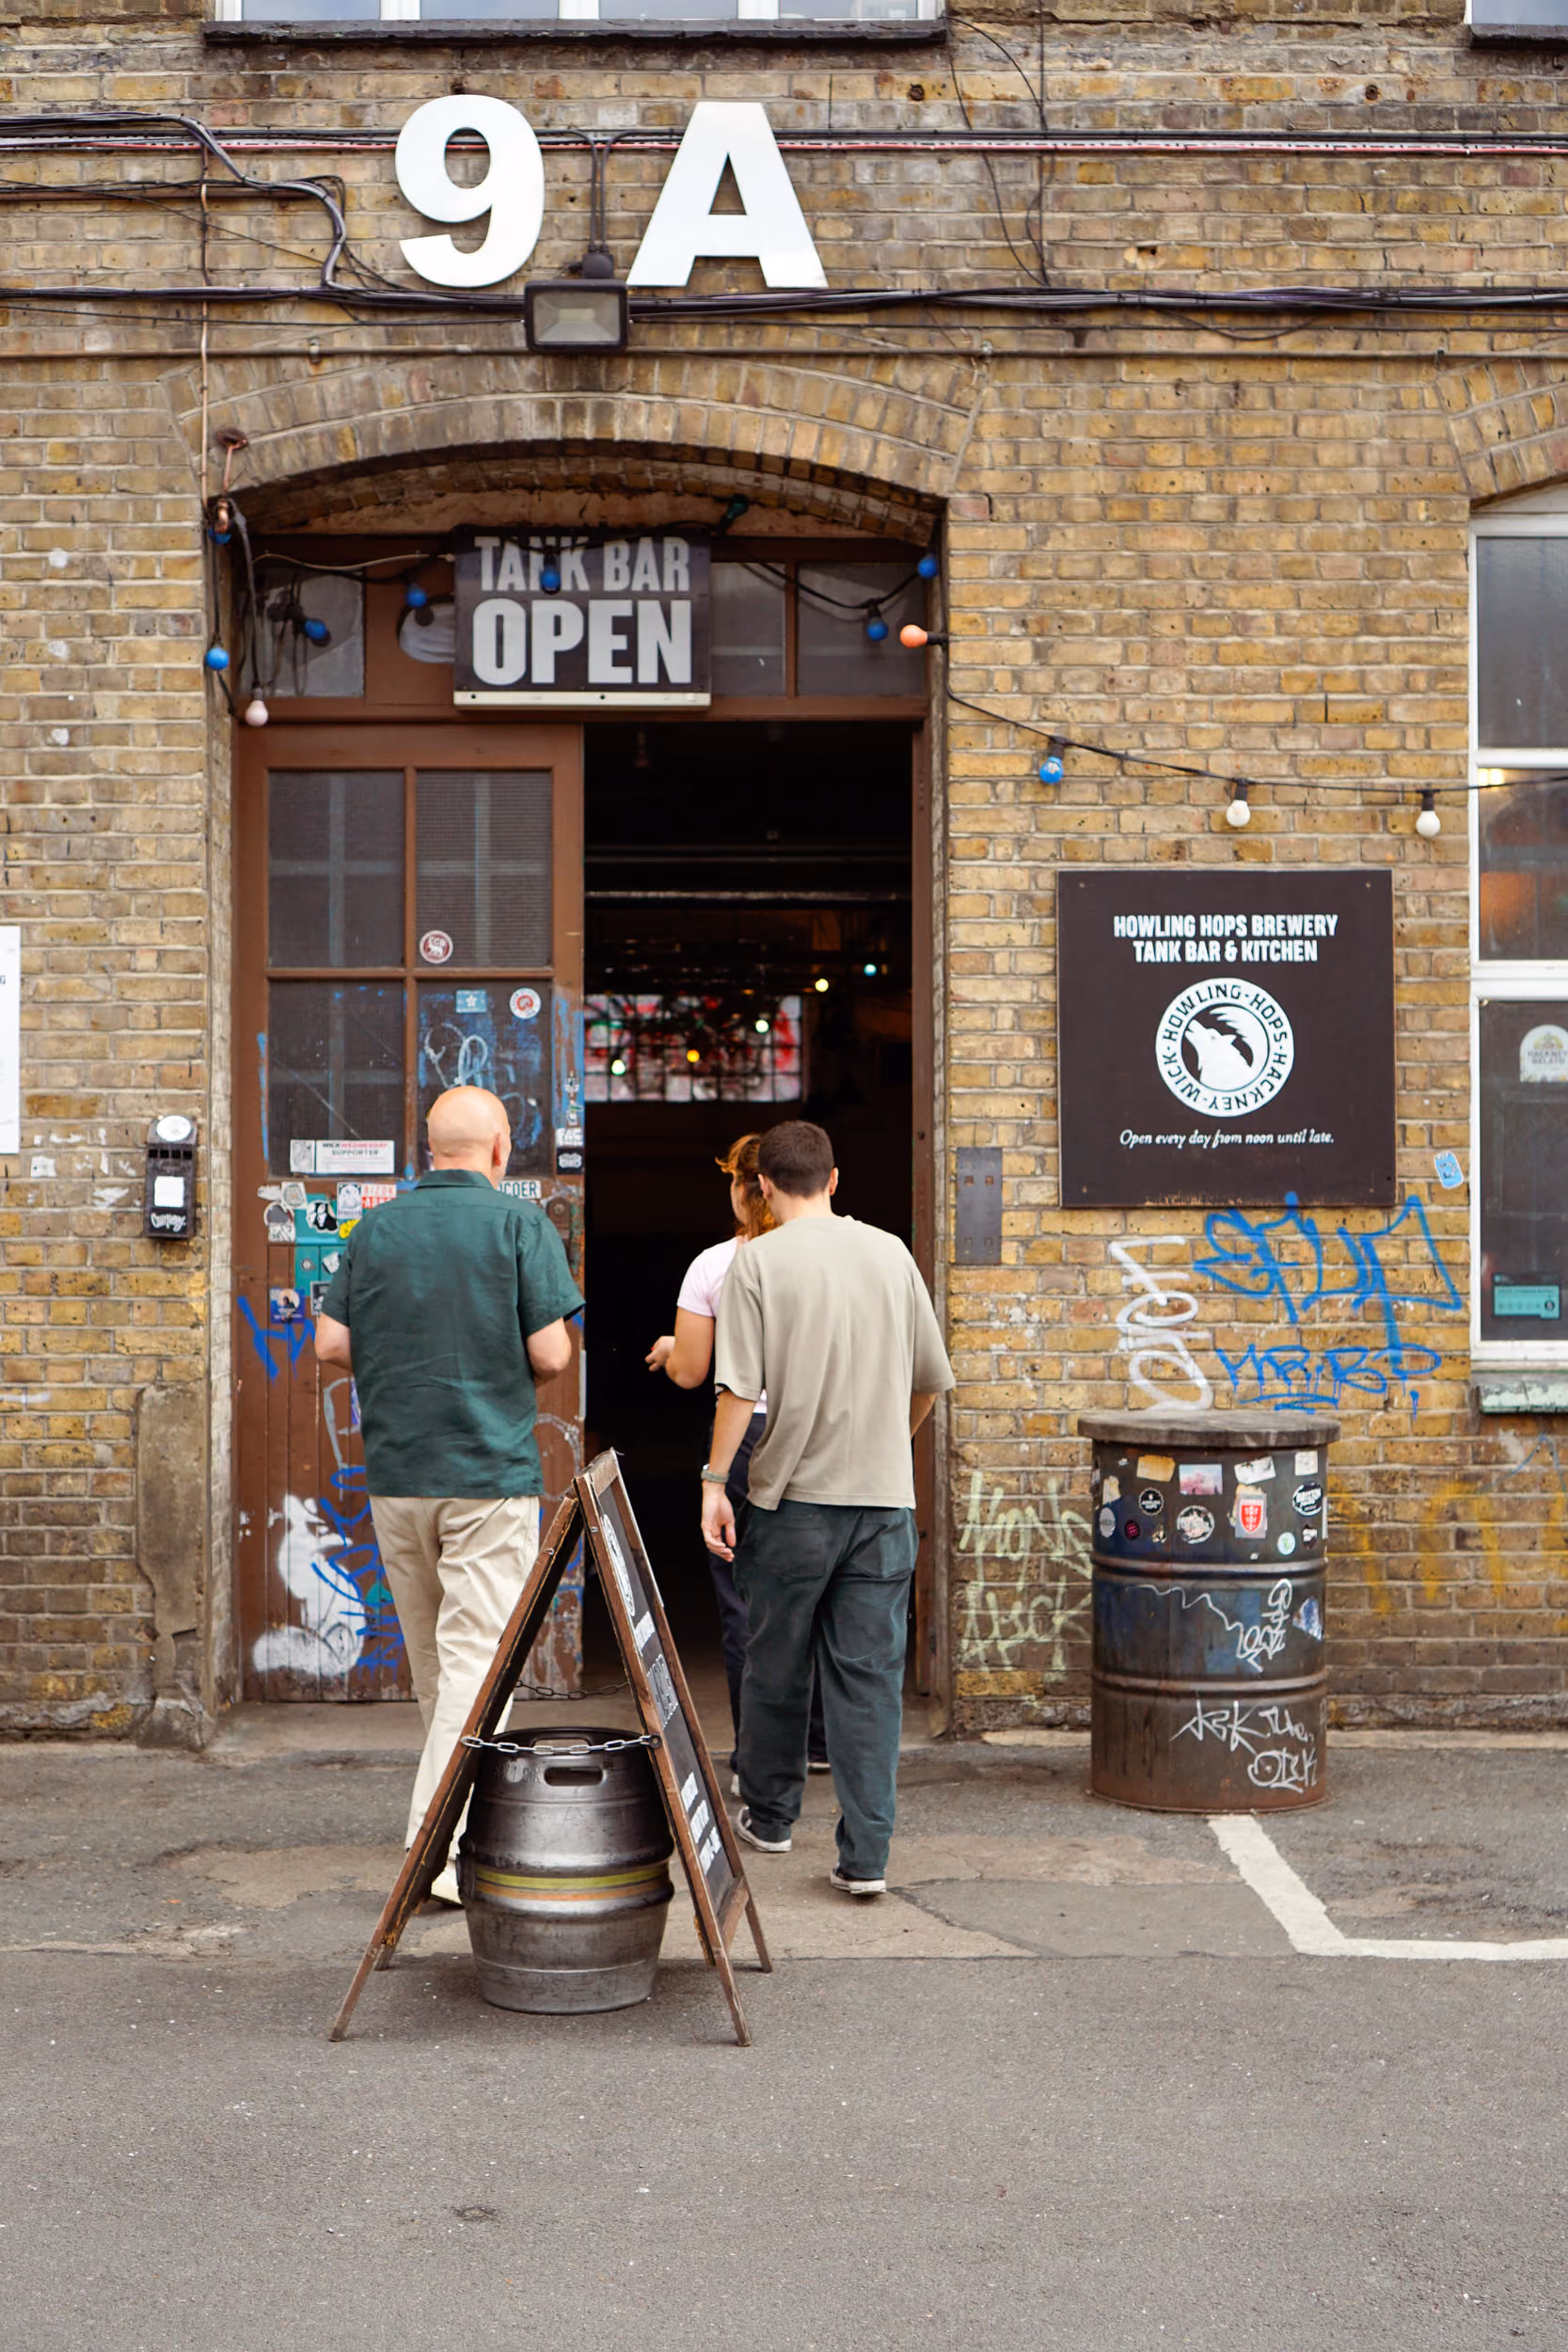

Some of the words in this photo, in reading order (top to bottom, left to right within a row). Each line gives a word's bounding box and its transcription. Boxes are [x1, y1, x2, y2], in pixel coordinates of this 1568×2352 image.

[394, 93, 545, 288] 9
[626, 101, 829, 289] A
[603, 536, 689, 591] BAR
[473, 598, 691, 685] OPEN
[1114, 914, 1196, 937] HOWLING
[1199, 914, 1247, 936] HOPS
[1251, 914, 1338, 936] BREWERY
[1132, 941, 1181, 962] TANK
[1185, 941, 1221, 961] BAR
[1225, 940, 1238, 962] &
[1241, 940, 1318, 961] KITCHEN
[1163, 983, 1242, 1041] HOWLING
[1249, 993, 1288, 1042] HOPS
[1163, 1051, 1200, 1102] WICK
[1208, 1052, 1288, 1110] HACKNEY
[1119, 1129, 1152, 1149] Open
[1155, 1134, 1186, 1149] every
[1189, 1129, 1212, 1149] day
[1212, 1129, 1242, 1149] from
[1245, 1135, 1274, 1144] noon
[1277, 1129, 1307, 1144] until
[1308, 1128, 1334, 1144] late.
